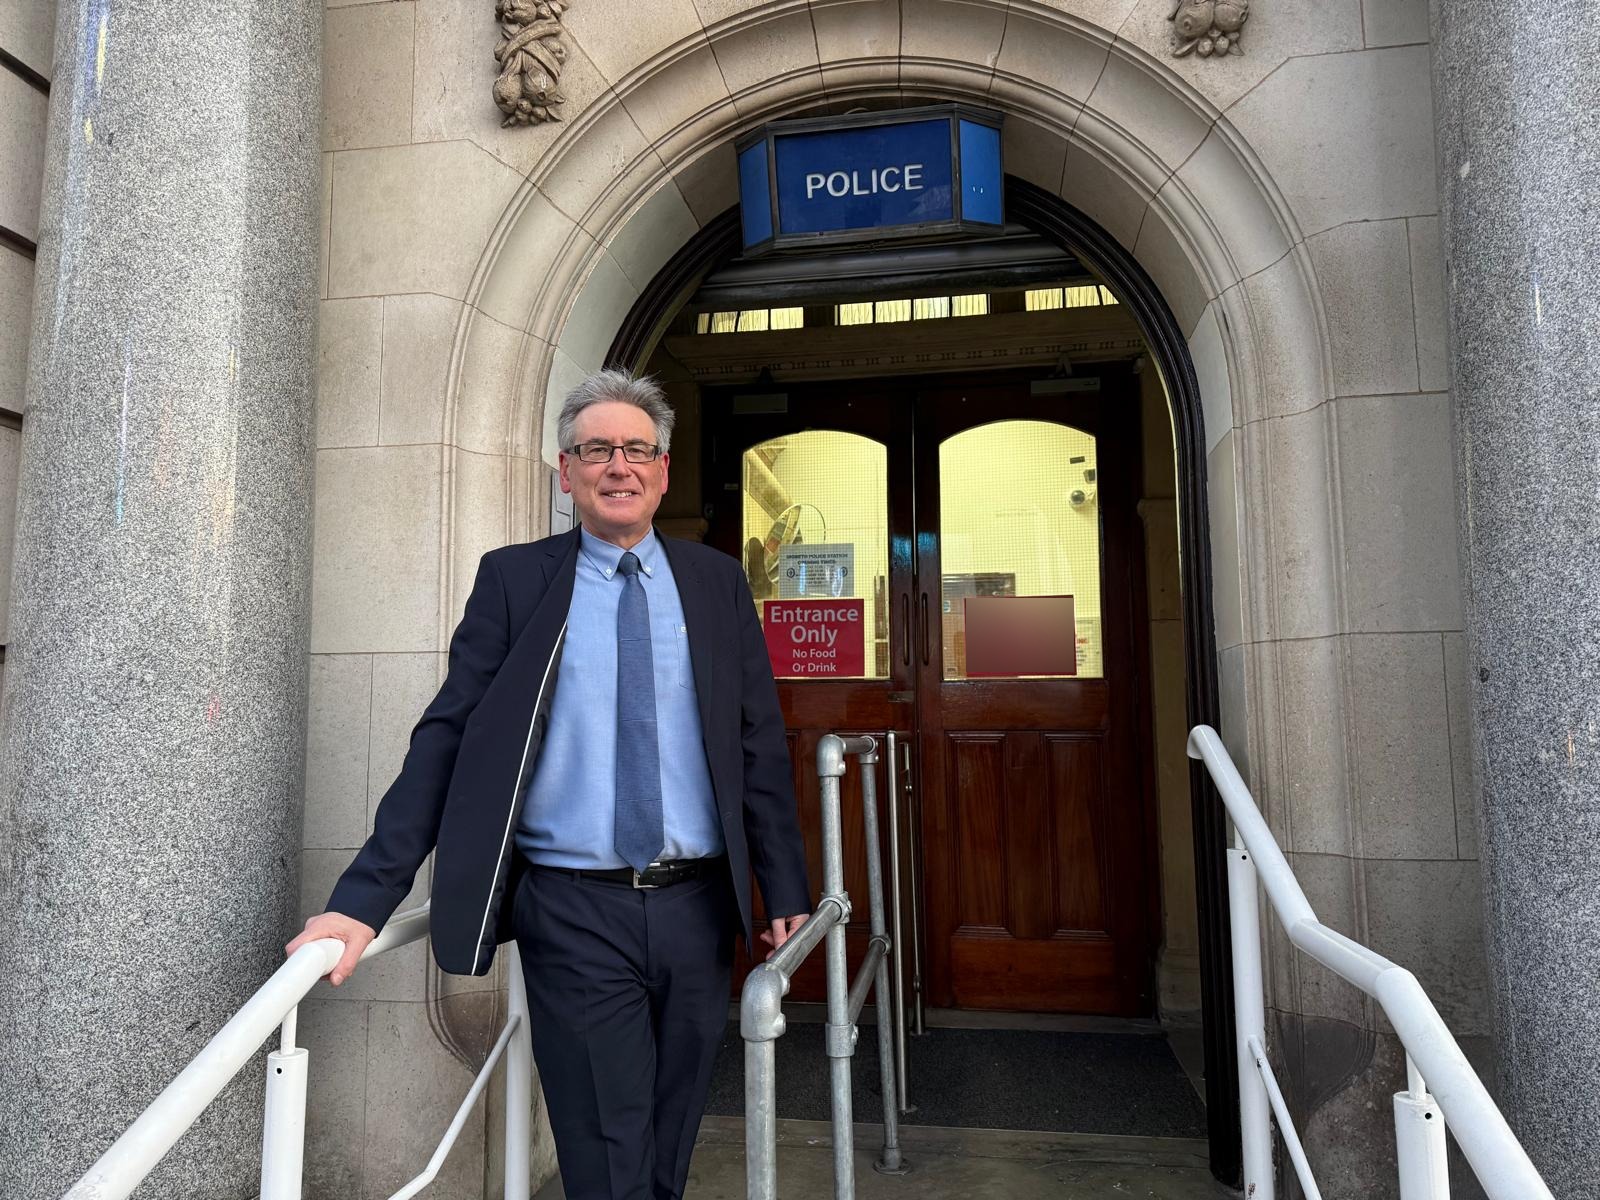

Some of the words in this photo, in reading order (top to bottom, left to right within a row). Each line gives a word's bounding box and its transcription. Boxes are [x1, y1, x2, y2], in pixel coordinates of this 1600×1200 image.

[806, 164, 923, 199] POLICE
[771, 606, 858, 623] Entrance
[791, 624, 838, 647] Only
[792, 649, 807, 658] No
[810, 648, 836, 658] Food
[792, 663, 805, 672] Or
[808, 662, 836, 672] Drink
